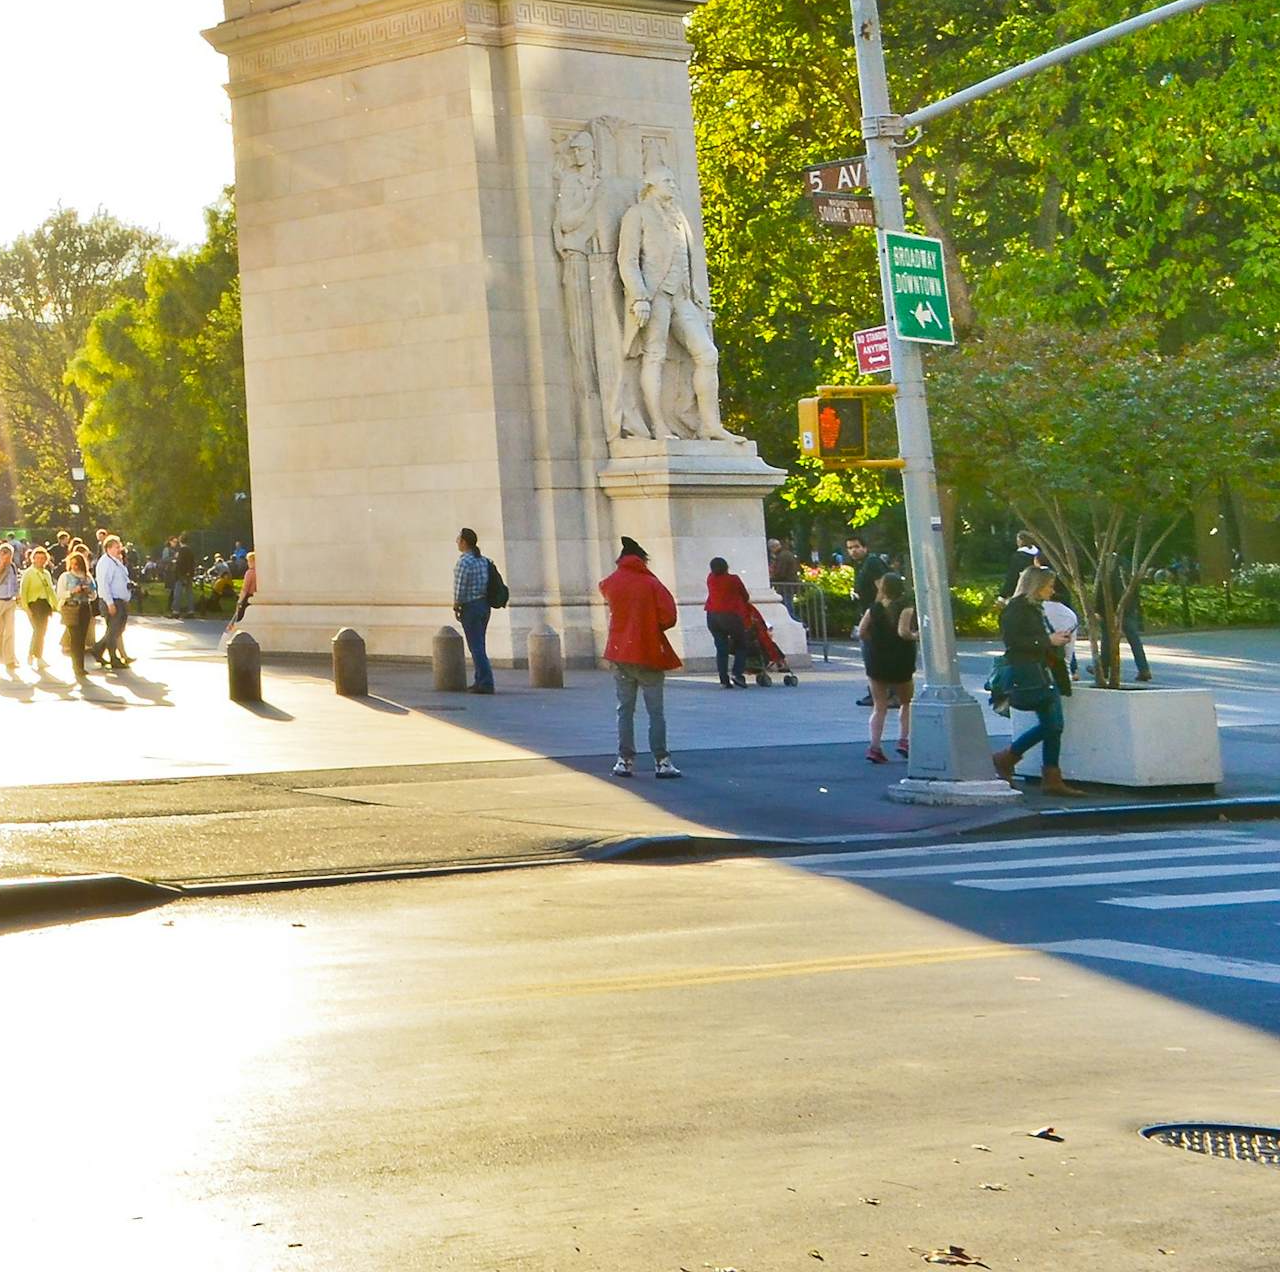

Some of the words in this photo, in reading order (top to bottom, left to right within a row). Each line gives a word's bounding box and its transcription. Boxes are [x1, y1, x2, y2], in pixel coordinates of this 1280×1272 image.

[809, 170, 823, 192] 5
[837, 163, 862, 189] AV
[893, 246, 937, 270] BROADWAY
[895, 272, 943, 297] DOWNTOWN
